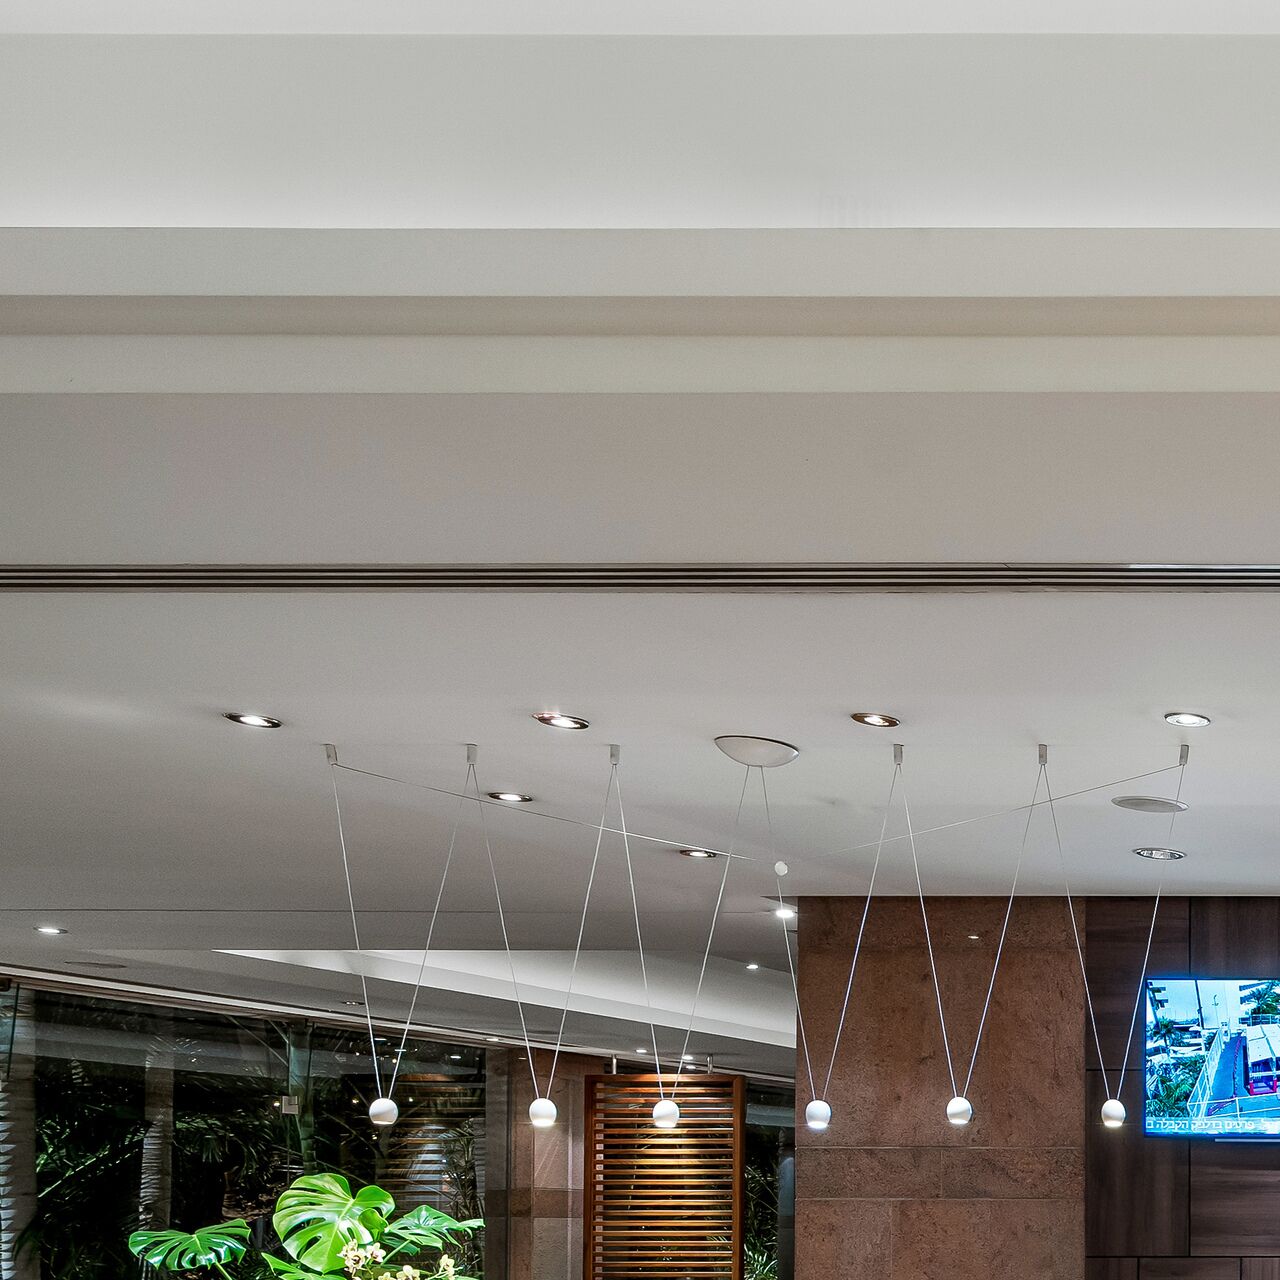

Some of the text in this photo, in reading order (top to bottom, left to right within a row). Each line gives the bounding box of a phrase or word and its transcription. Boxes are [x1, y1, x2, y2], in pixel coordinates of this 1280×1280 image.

[1156, 1118, 1189, 1130] הקבלה
[1191, 1118, 1222, 1131] בדלפק
[1225, 1120, 1254, 1129] פרטים
